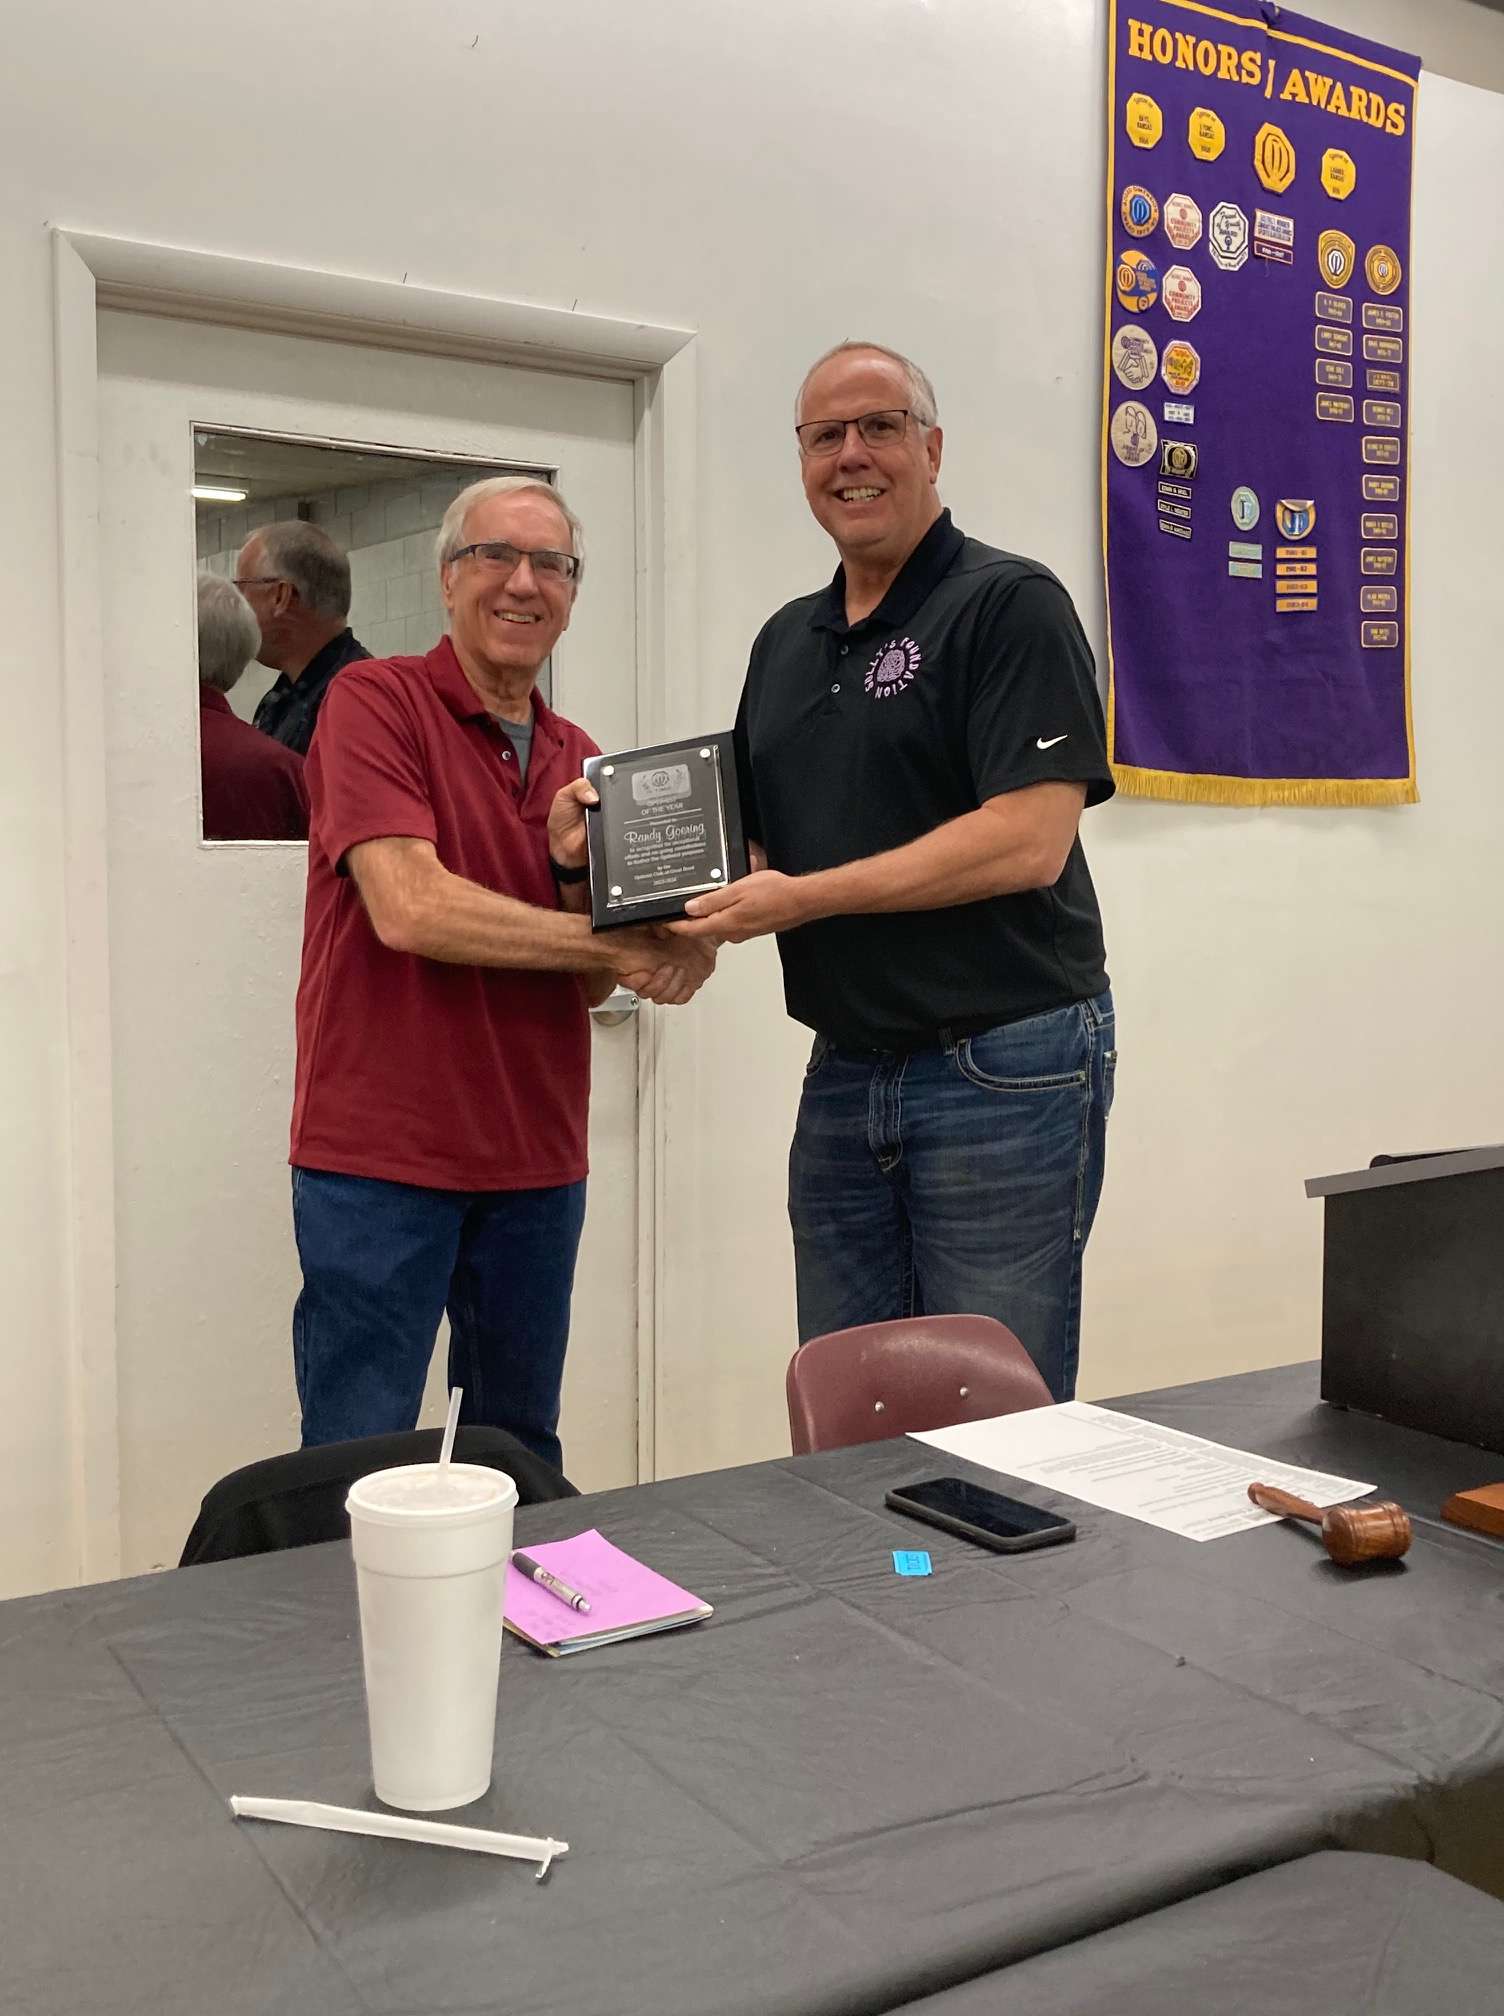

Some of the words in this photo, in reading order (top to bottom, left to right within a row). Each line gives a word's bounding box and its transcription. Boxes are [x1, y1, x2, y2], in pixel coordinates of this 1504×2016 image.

[1127, 18, 1262, 86] HONORS
[1280, 68, 1405, 136] AWARDS
[875, 637, 921, 698] FOUNDATION
[666, 802, 684, 810] YEAR
[624, 828, 661, 844] Randy
[666, 824, 704, 840] Goering
